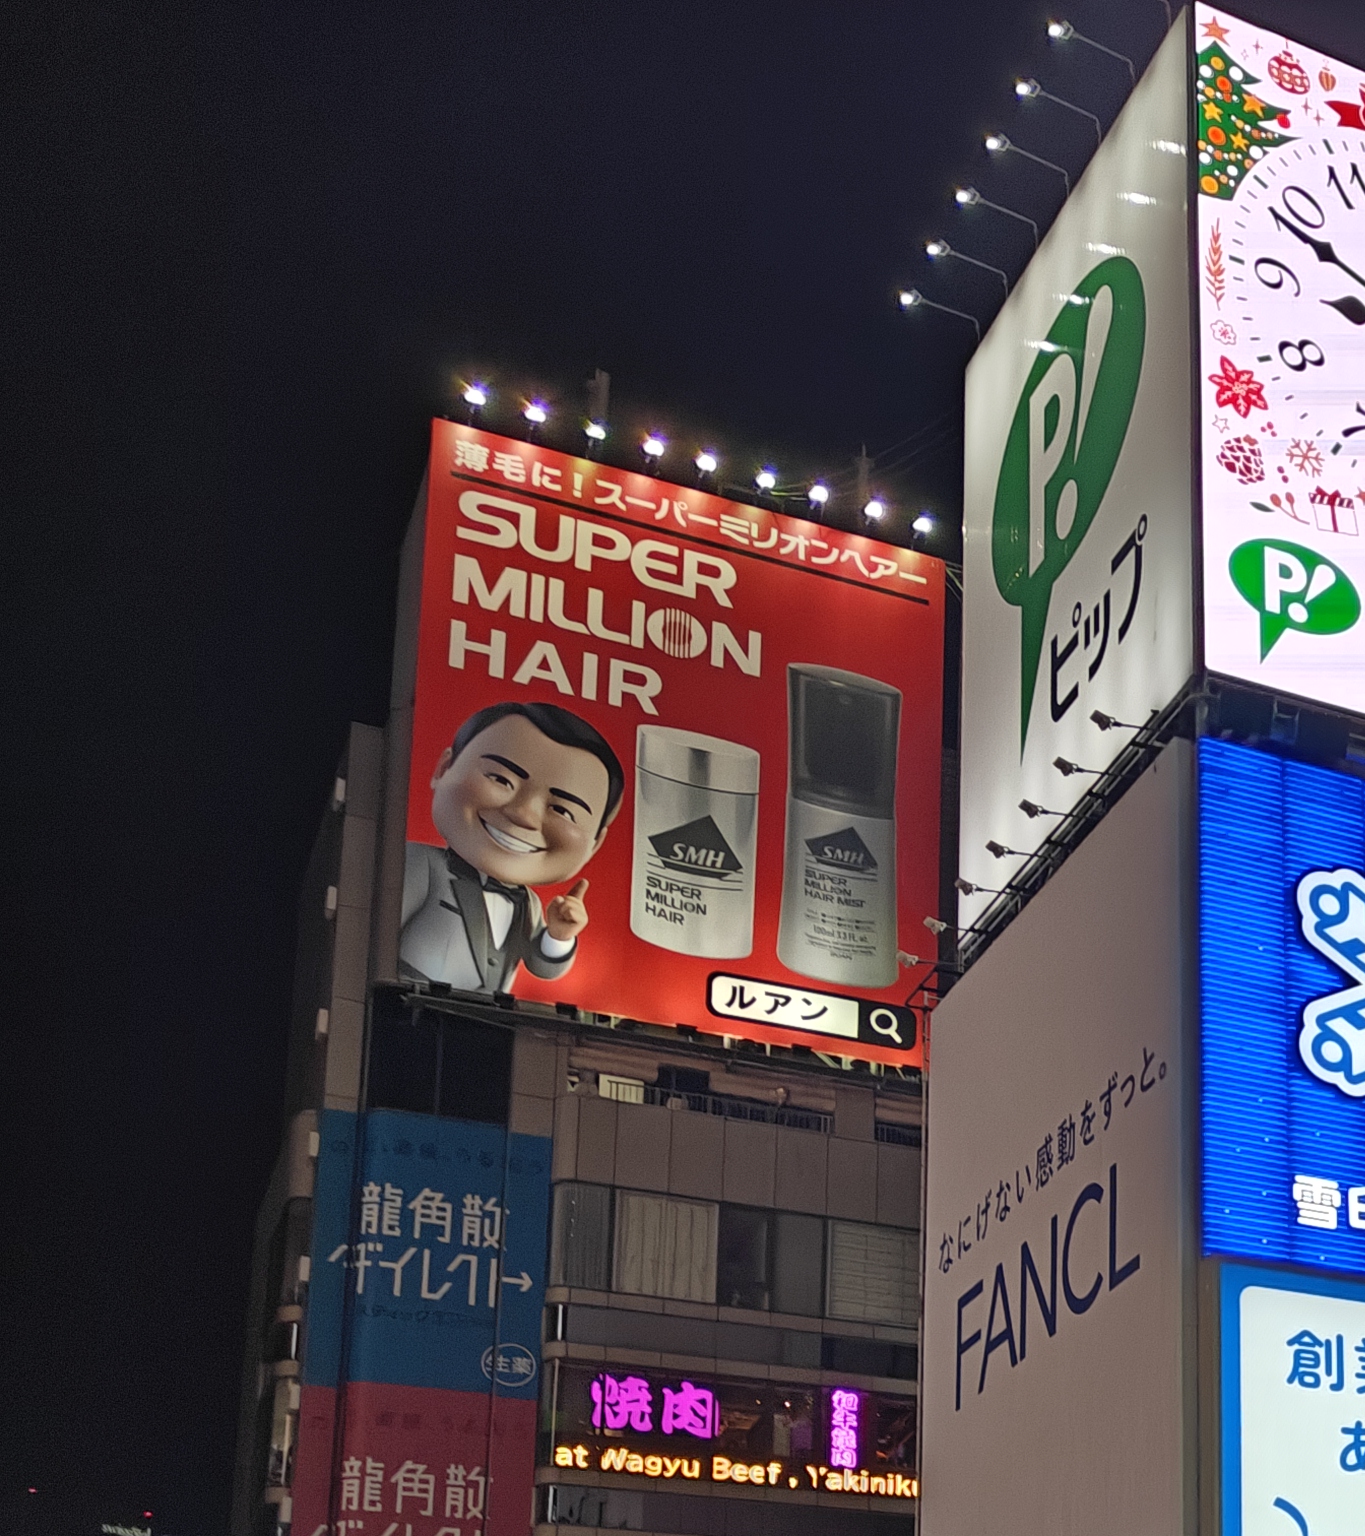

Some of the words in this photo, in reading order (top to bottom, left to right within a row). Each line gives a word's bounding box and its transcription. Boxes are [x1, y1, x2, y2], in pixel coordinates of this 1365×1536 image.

[1267, 185, 1326, 243] 10
[1253, 257, 1300, 297] 9
[1278, 339, 1325, 372] 8
[456, 490, 737, 608] SUPER
[452, 555, 762, 677] MILLION
[1049, 515, 1148, 723] ピップ
[448, 619, 662, 715] HAIR
[670, 843, 725, 868] SMH
[804, 869, 848, 887] SUPER
[821, 846, 864, 865] SMH
[645, 888, 707, 916] MILLION
[645, 903, 685, 926] HAIR
[646, 876, 702, 901] SUPER
[725, 984, 829, 1022] ルアン
[939, 1047, 1167, 1274] なにげない感動をずっと。
[361, 1181, 509, 1252] 龍角散
[328, 1242, 498, 1308] ダイレクト
[955, 1163, 1141, 1412] FANCL
[591, 1373, 720, 1439] 焼肉
[342, 1456, 493, 1521] 龍角散
[600, 1447, 700, 1480] Wagyu
